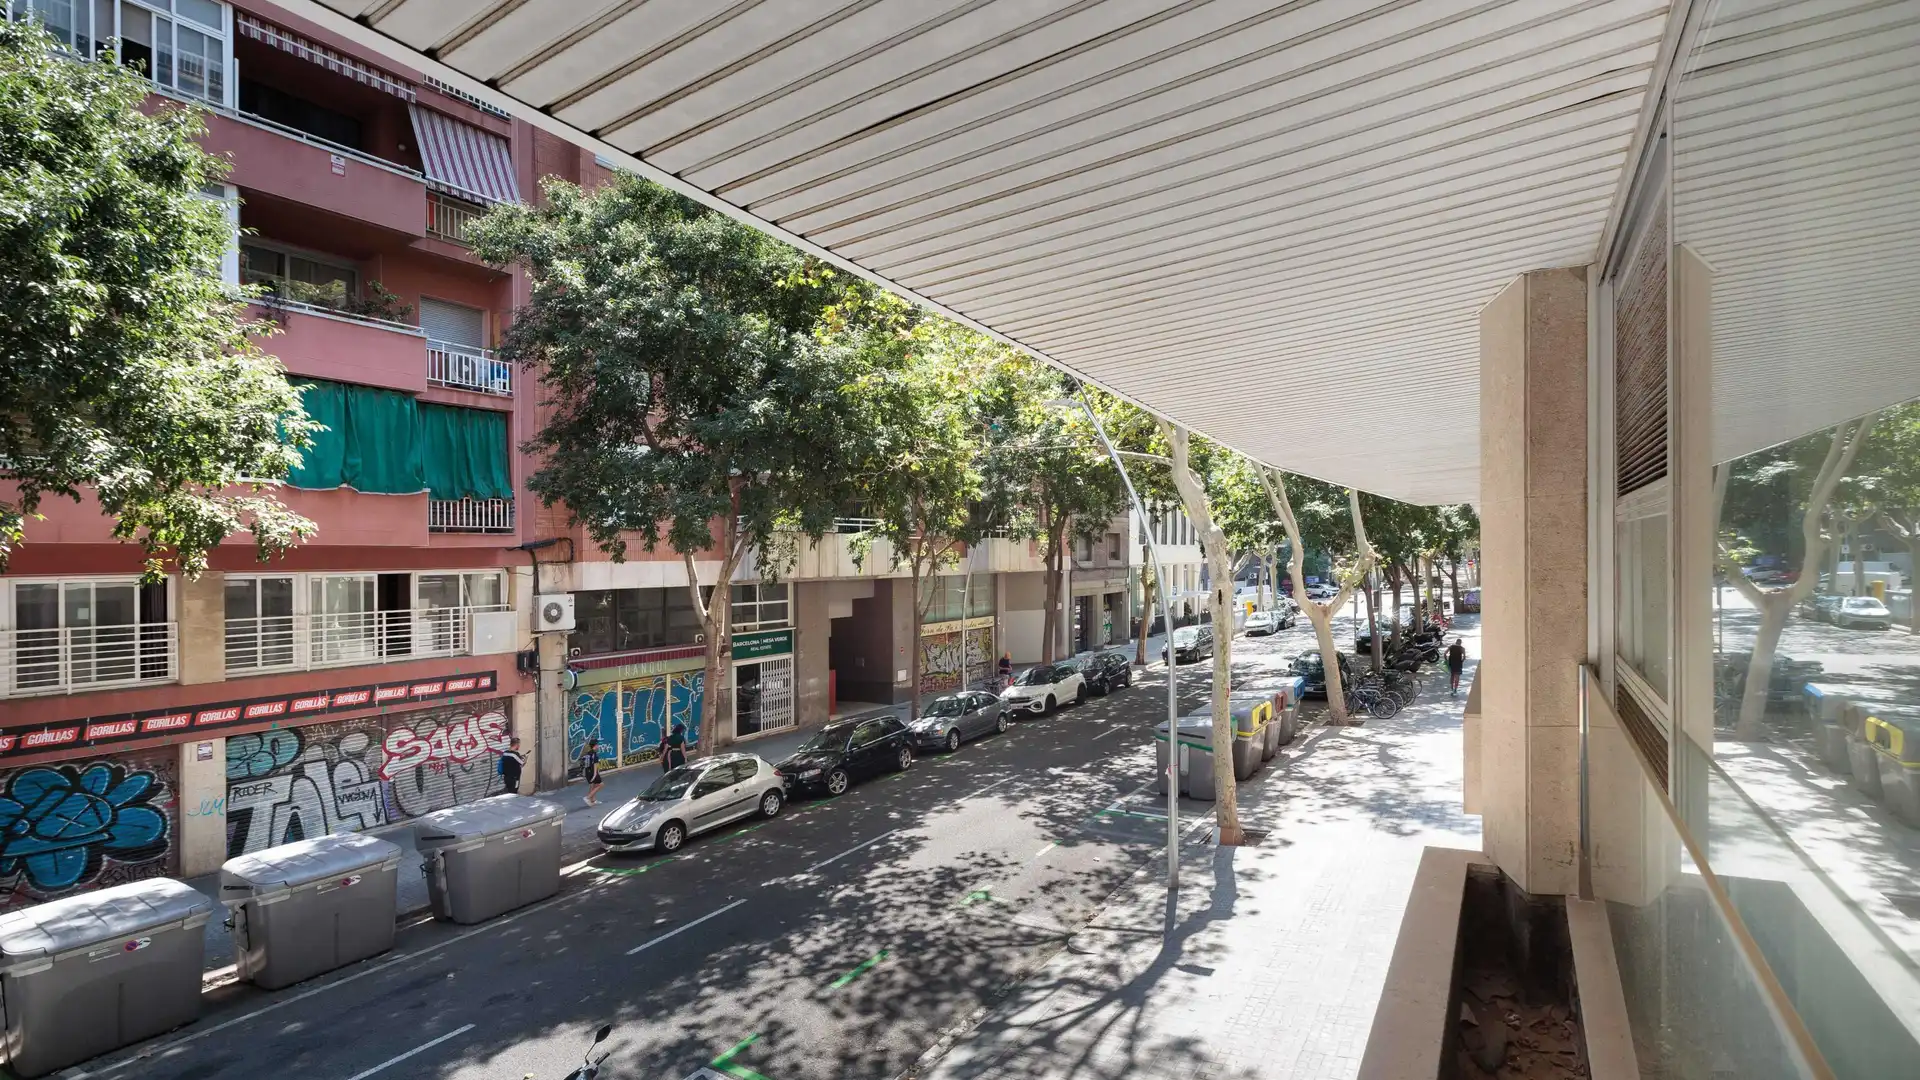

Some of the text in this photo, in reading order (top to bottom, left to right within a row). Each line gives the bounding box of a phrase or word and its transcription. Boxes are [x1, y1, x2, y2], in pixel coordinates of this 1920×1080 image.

[733, 639, 760, 647] BARCELONA
[27, 730, 74, 745] GORILLAS
[90, 722, 132, 737] GORILLAS
[146, 715, 187, 729] GORILLAS
[199, 710, 237, 722] GORILLAS
[248, 703, 283, 716] GORILLAS
[294, 697, 327, 710] GORILLAS
[337, 692, 367, 704] GORILLAS
[413, 683, 441, 694] GORILLAS
[448, 680, 473, 690] GORILLAS
